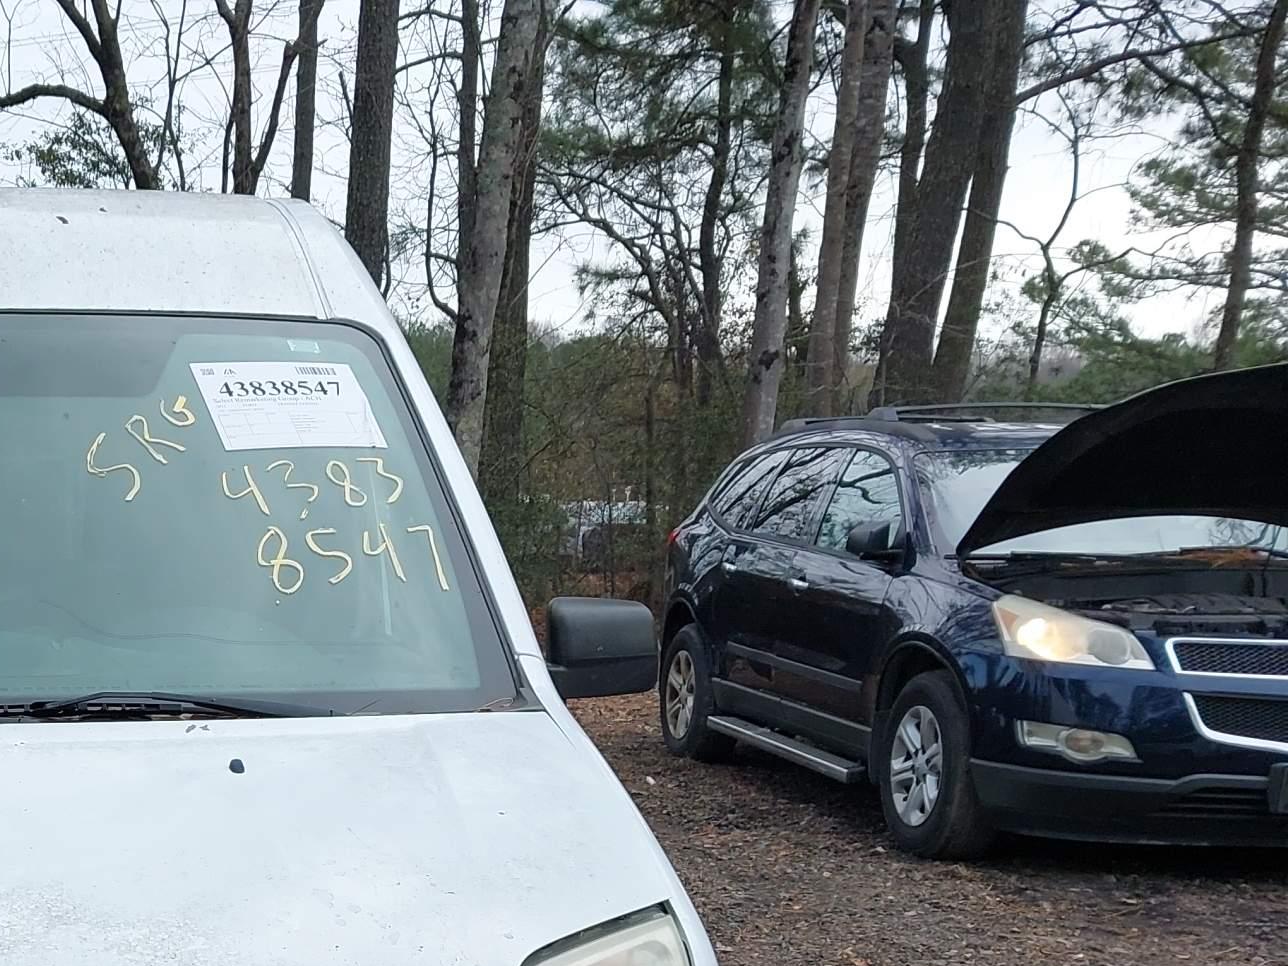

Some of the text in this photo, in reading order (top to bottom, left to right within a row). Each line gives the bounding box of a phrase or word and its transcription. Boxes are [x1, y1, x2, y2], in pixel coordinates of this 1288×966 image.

[219, 380, 340, 398] 43838547
[222, 457, 404, 517] 4383
[257, 522, 450, 595] 8547
